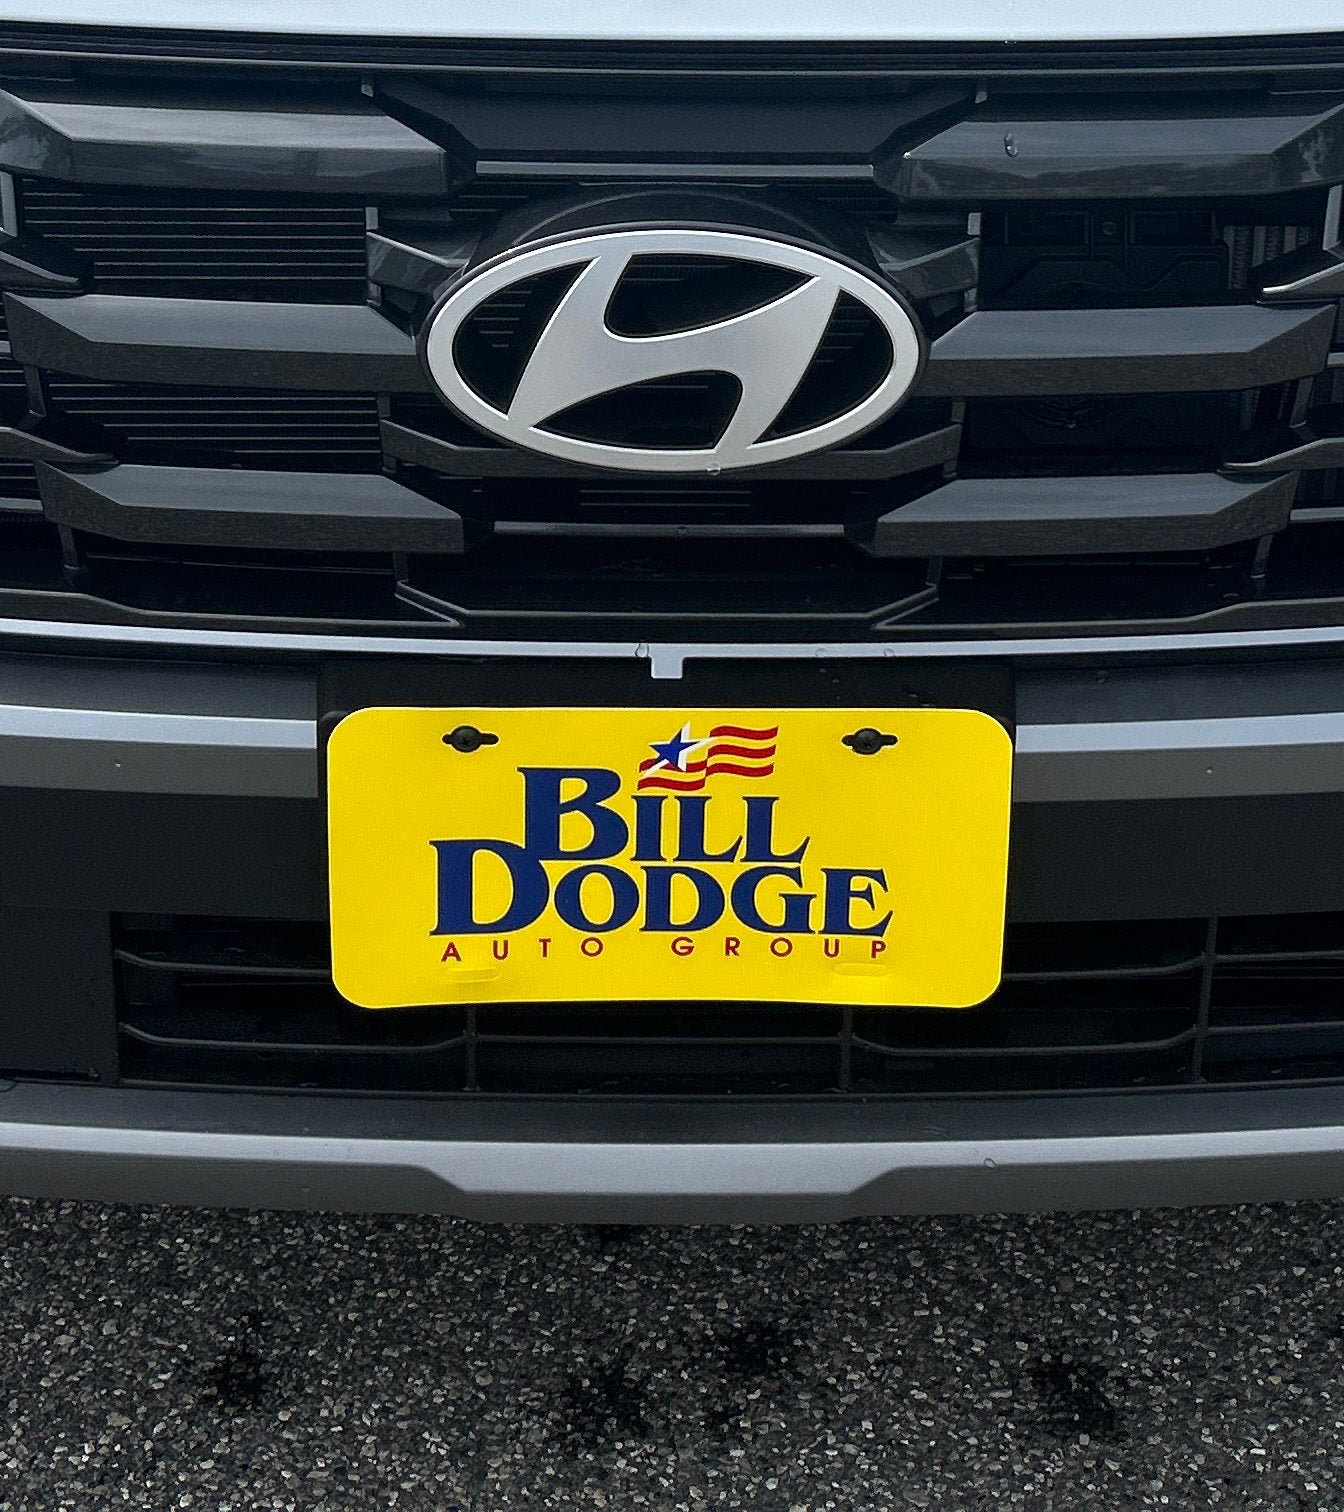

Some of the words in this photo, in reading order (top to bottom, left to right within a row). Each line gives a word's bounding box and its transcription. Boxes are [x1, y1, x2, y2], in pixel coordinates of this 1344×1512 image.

[517, 766, 810, 863] BILL
[429, 838, 894, 937] DODGE
[440, 936, 606, 963] AUTO
[670, 936, 888, 960] GROUP
